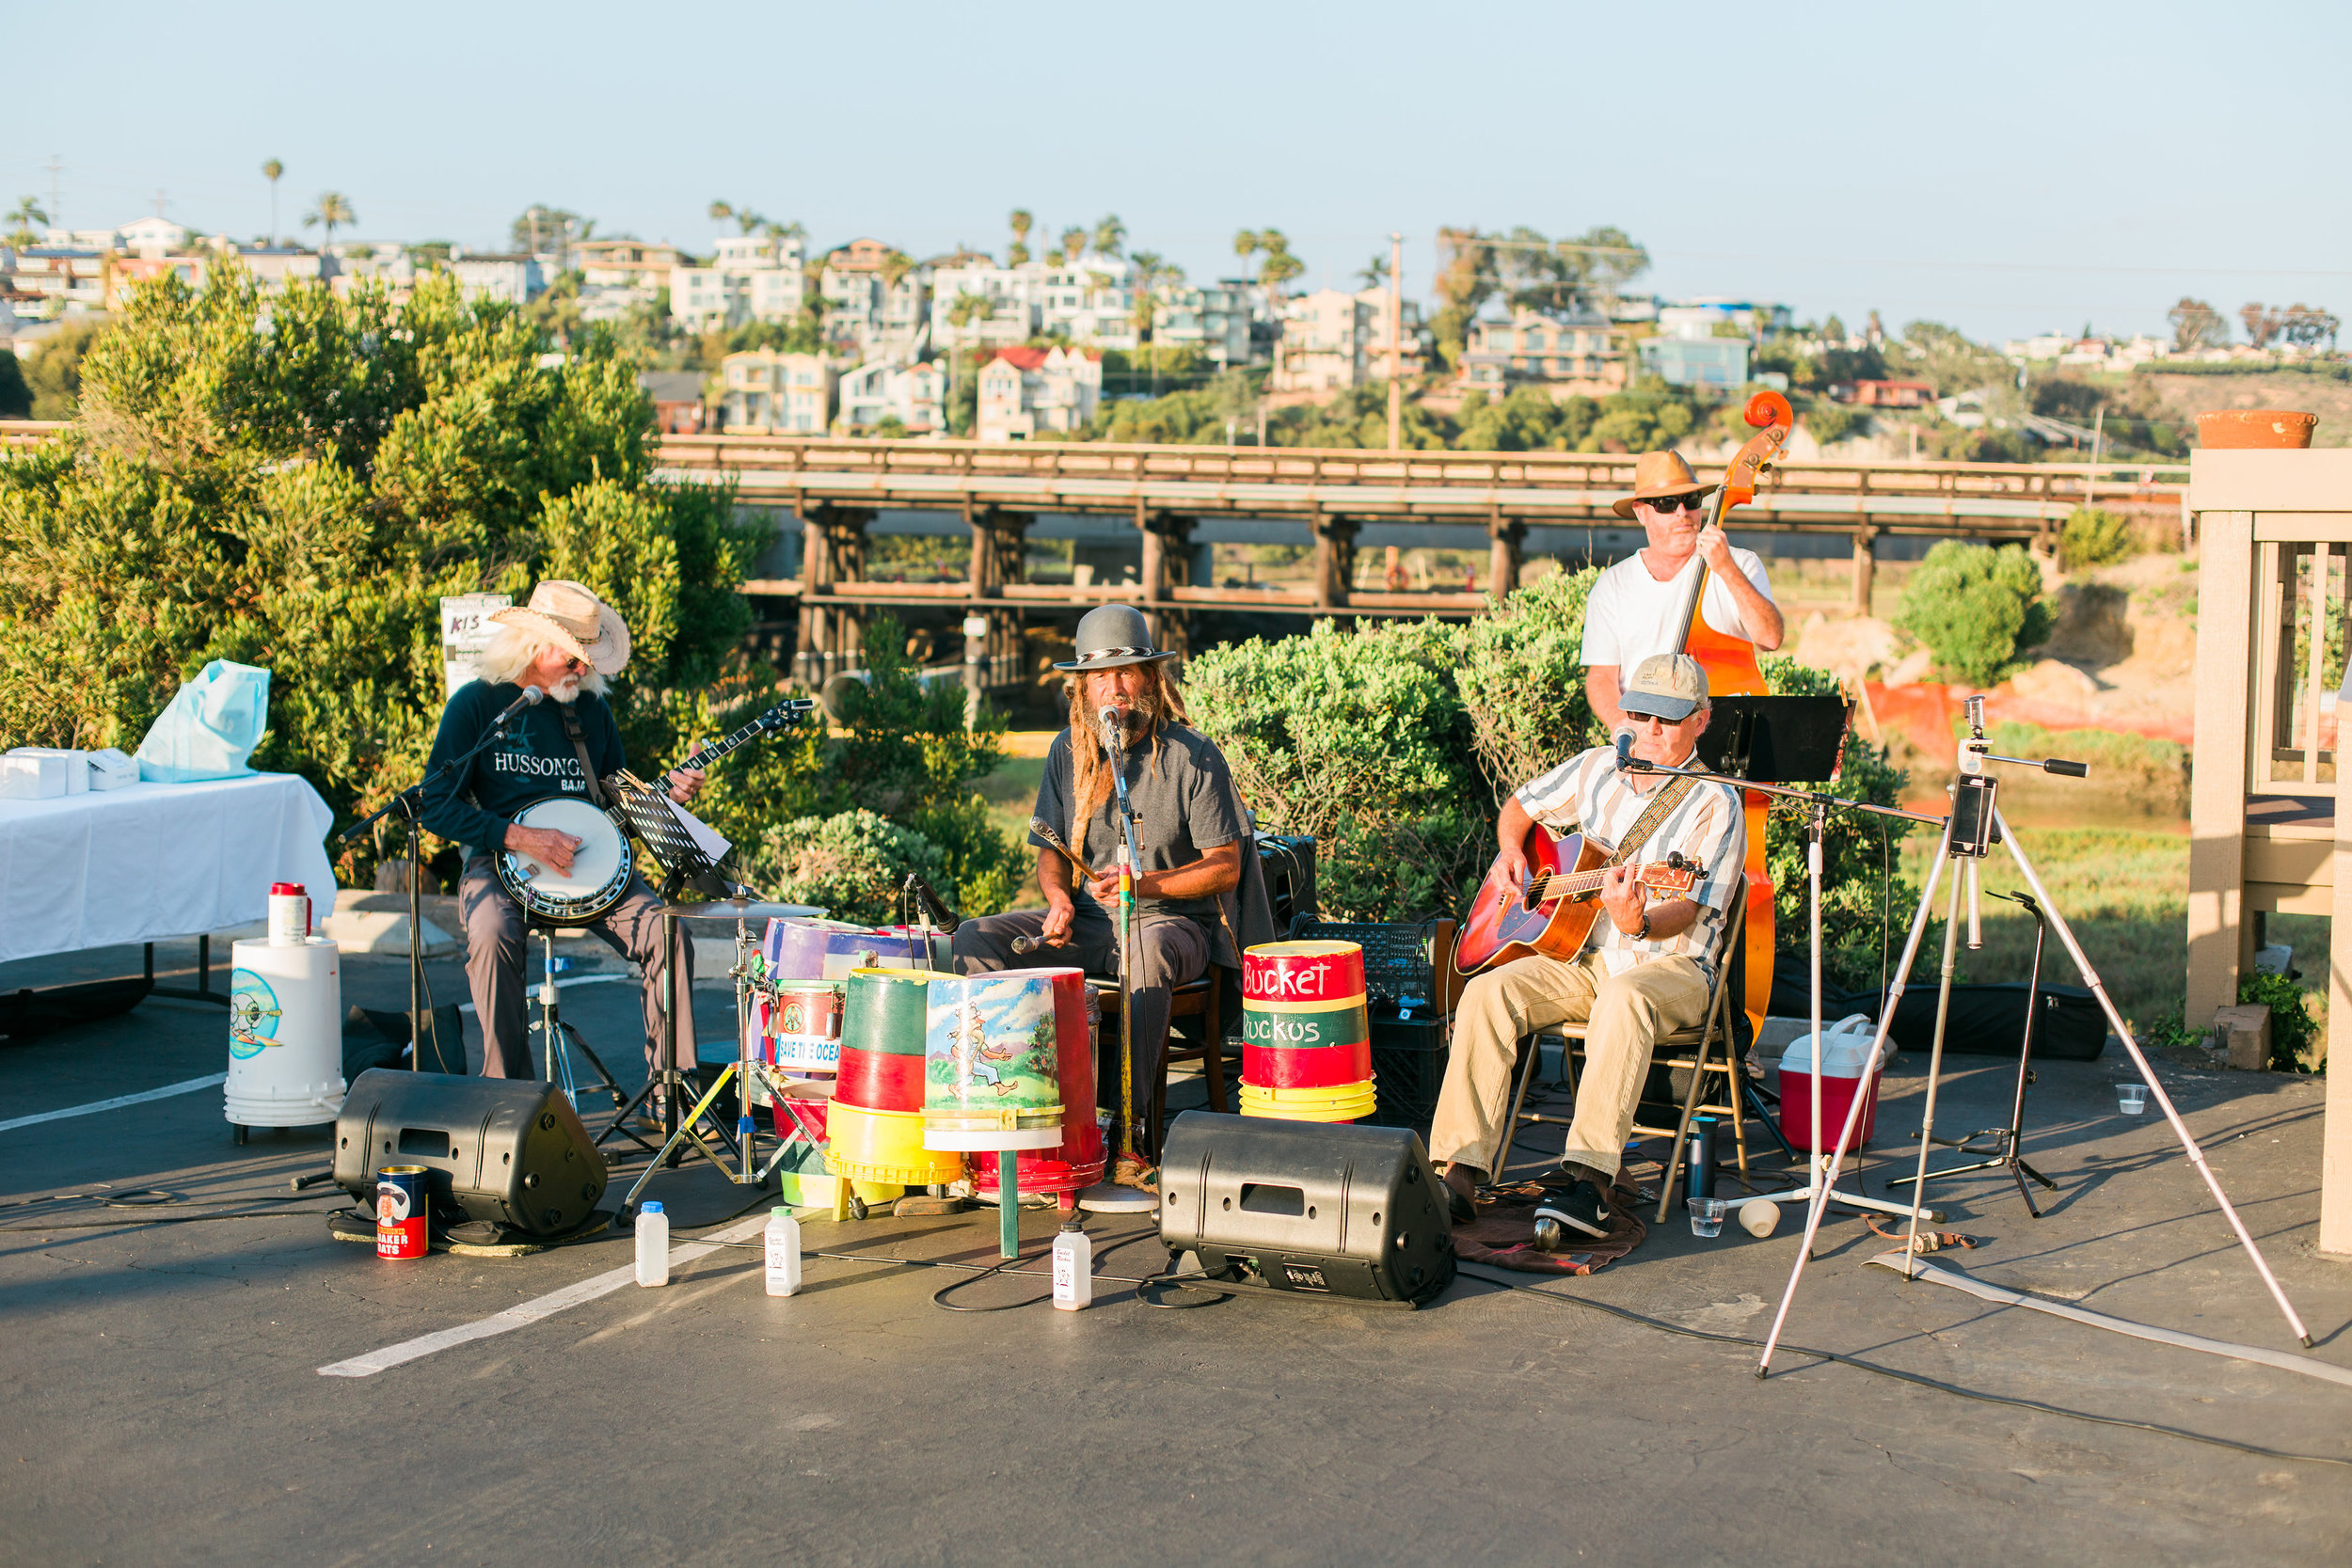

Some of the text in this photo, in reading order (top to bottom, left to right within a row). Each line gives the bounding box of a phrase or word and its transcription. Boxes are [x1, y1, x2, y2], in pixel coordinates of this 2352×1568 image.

[494, 752, 584, 777] HUSSONG
[1244, 960, 1331, 996] Bucket
[1243, 1010, 1320, 1042] Ruckus
[781, 1040, 796, 1058] SAVE
[816, 1043, 840, 1062] OCEA
[377, 1233, 408, 1244] UAKER
